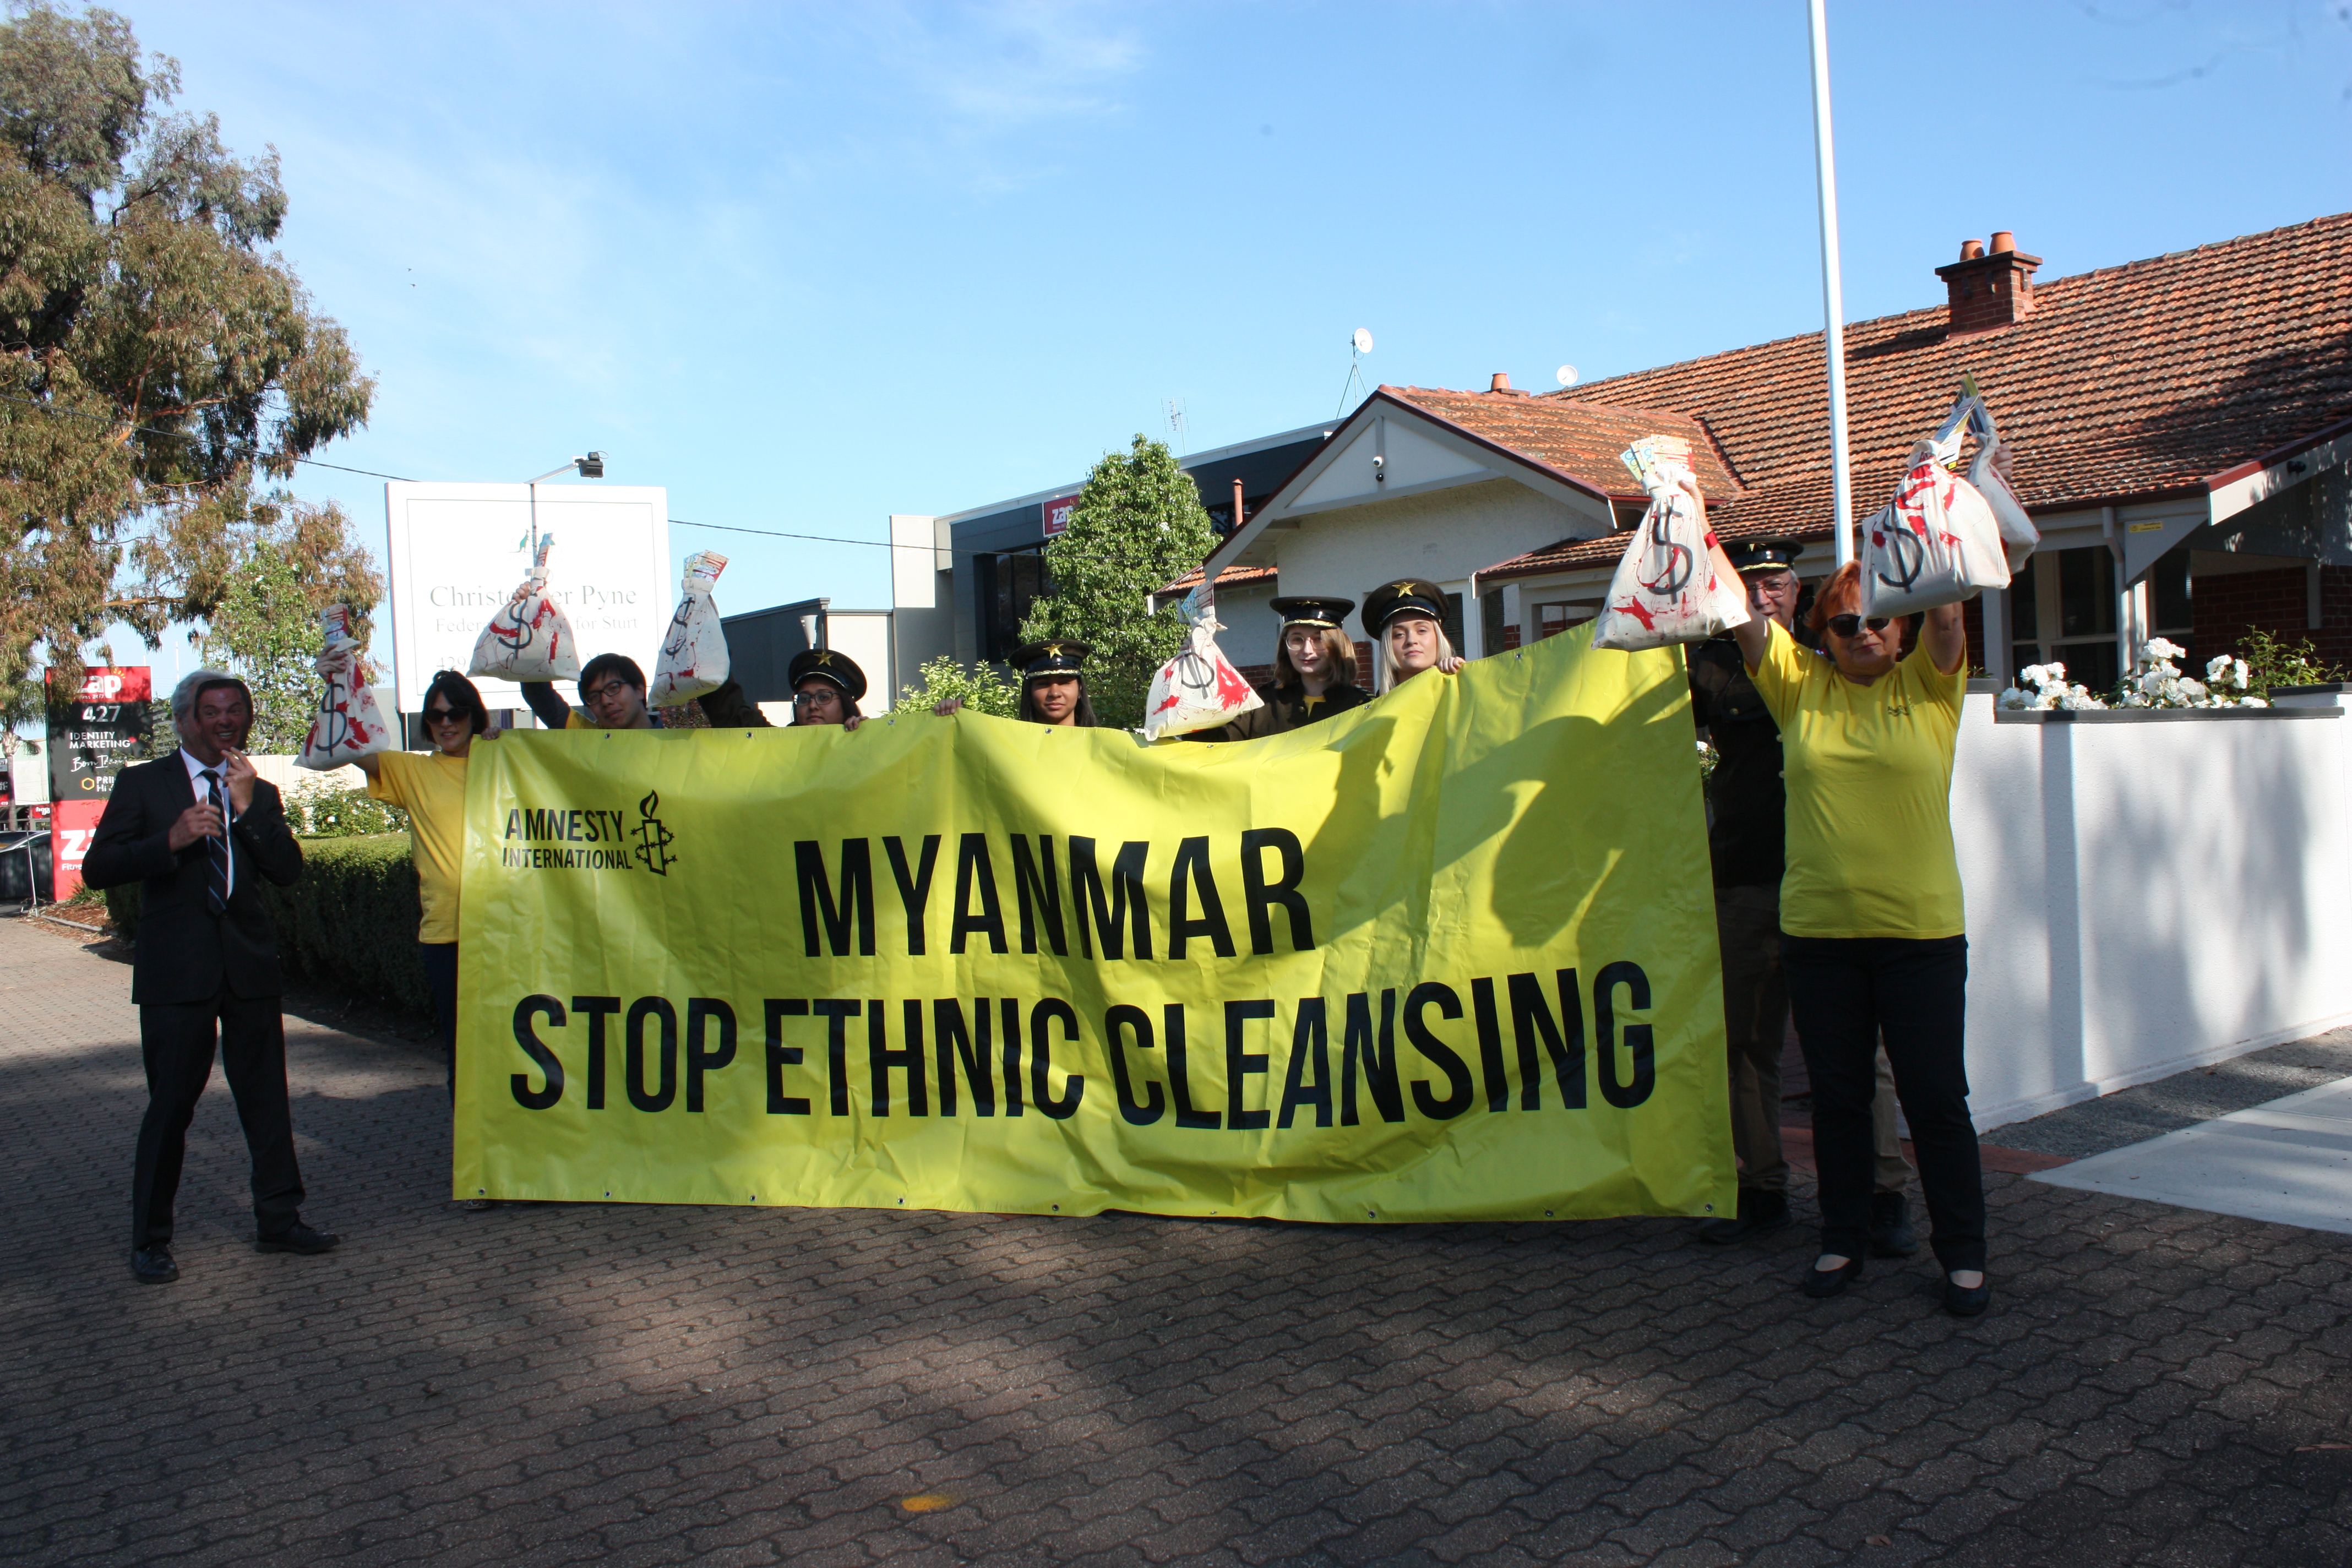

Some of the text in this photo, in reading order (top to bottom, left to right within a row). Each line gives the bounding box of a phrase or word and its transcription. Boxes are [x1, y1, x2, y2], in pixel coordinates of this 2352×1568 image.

[581, 585, 638, 610] Pyne
[575, 616, 597, 630] for
[602, 615, 638, 630] Sturt
[435, 656, 466, 670] 429
[83, 705, 122, 722] 427
[69, 731, 115, 741] IDENTITY
[69, 739, 131, 749] MARKETING
[505, 809, 624, 842] AMNESTY
[503, 847, 634, 869] INTERNATIONAL
[794, 827, 1315, 960] MYANMAR
[510, 960, 1656, 1130] STOP ETHNIC CLEANSING
